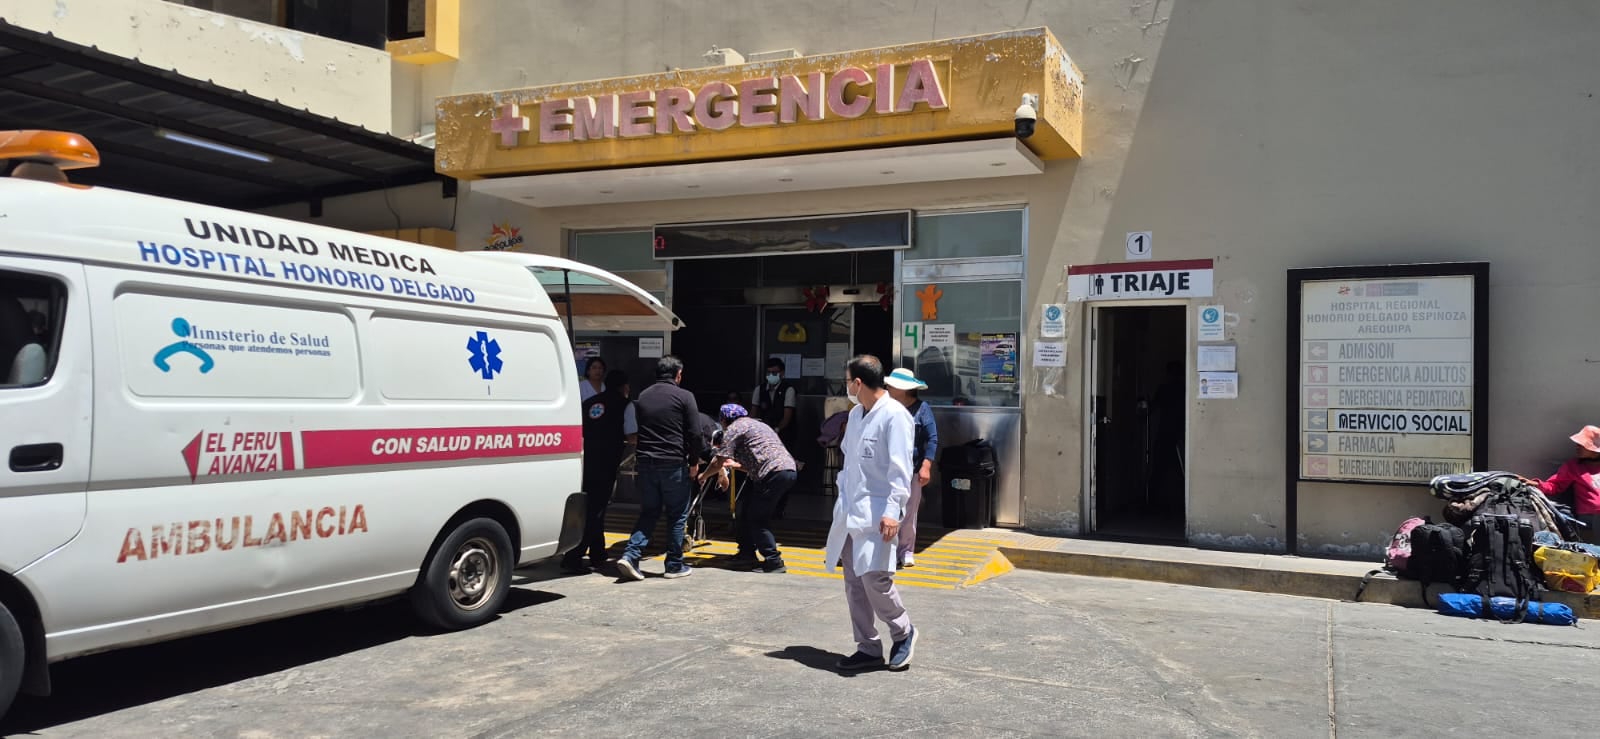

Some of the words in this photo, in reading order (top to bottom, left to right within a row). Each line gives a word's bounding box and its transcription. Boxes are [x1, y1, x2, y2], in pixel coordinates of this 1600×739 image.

[538, 58, 949, 144] EMERGENCIA
[184, 217, 319, 256] UNIDAD
[328, 241, 437, 276] MEDICA
[1134, 235, 1144, 252] 1
[137, 240, 275, 278] HOSPITAL
[281, 261, 385, 292] HONORIO
[390, 276, 475, 303] DELGADO
[1111, 271, 1190, 295] TRIAJE
[1331, 301, 1382, 311] HOSPITAL
[1386, 300, 1441, 310] REGIONAL
[1307, 313, 1354, 323] HONORIO
[1358, 312, 1408, 322] DELGADO
[1412, 311, 1467, 321] ESPINOZA
[183, 324, 265, 344] Ministerio
[269, 331, 286, 345] de
[290, 332, 330, 348] Salud
[905, 325, 918, 348] 4
[1358, 324, 1412, 334] AREQUIPA
[183, 340, 226, 351] Personas
[228, 344, 245, 353] que
[248, 345, 293, 355] atendemos
[295, 348, 331, 357] personas
[1339, 342, 1395, 359] ADMISION
[1339, 366, 1411, 383] EMERGENCIA
[1414, 366, 1466, 383] ADULTOS
[1339, 389, 1403, 406] EMERGENCIA
[1406, 390, 1466, 407] PEDIATRICA
[1412, 414, 1467, 432] SOCIAL
[205, 432, 226, 453] EL
[232, 431, 278, 451] PERU
[371, 437, 412, 455] CON
[416, 436, 471, 453] SALUD
[475, 433, 513, 450] PARA
[517, 432, 562, 448] TODOS
[1339, 436, 1395, 453] FARMACIA
[207, 453, 277, 475] AVANZA
[1339, 458, 1391, 476] EMERGENCIA
[116, 503, 369, 563] AMBULANCIA
